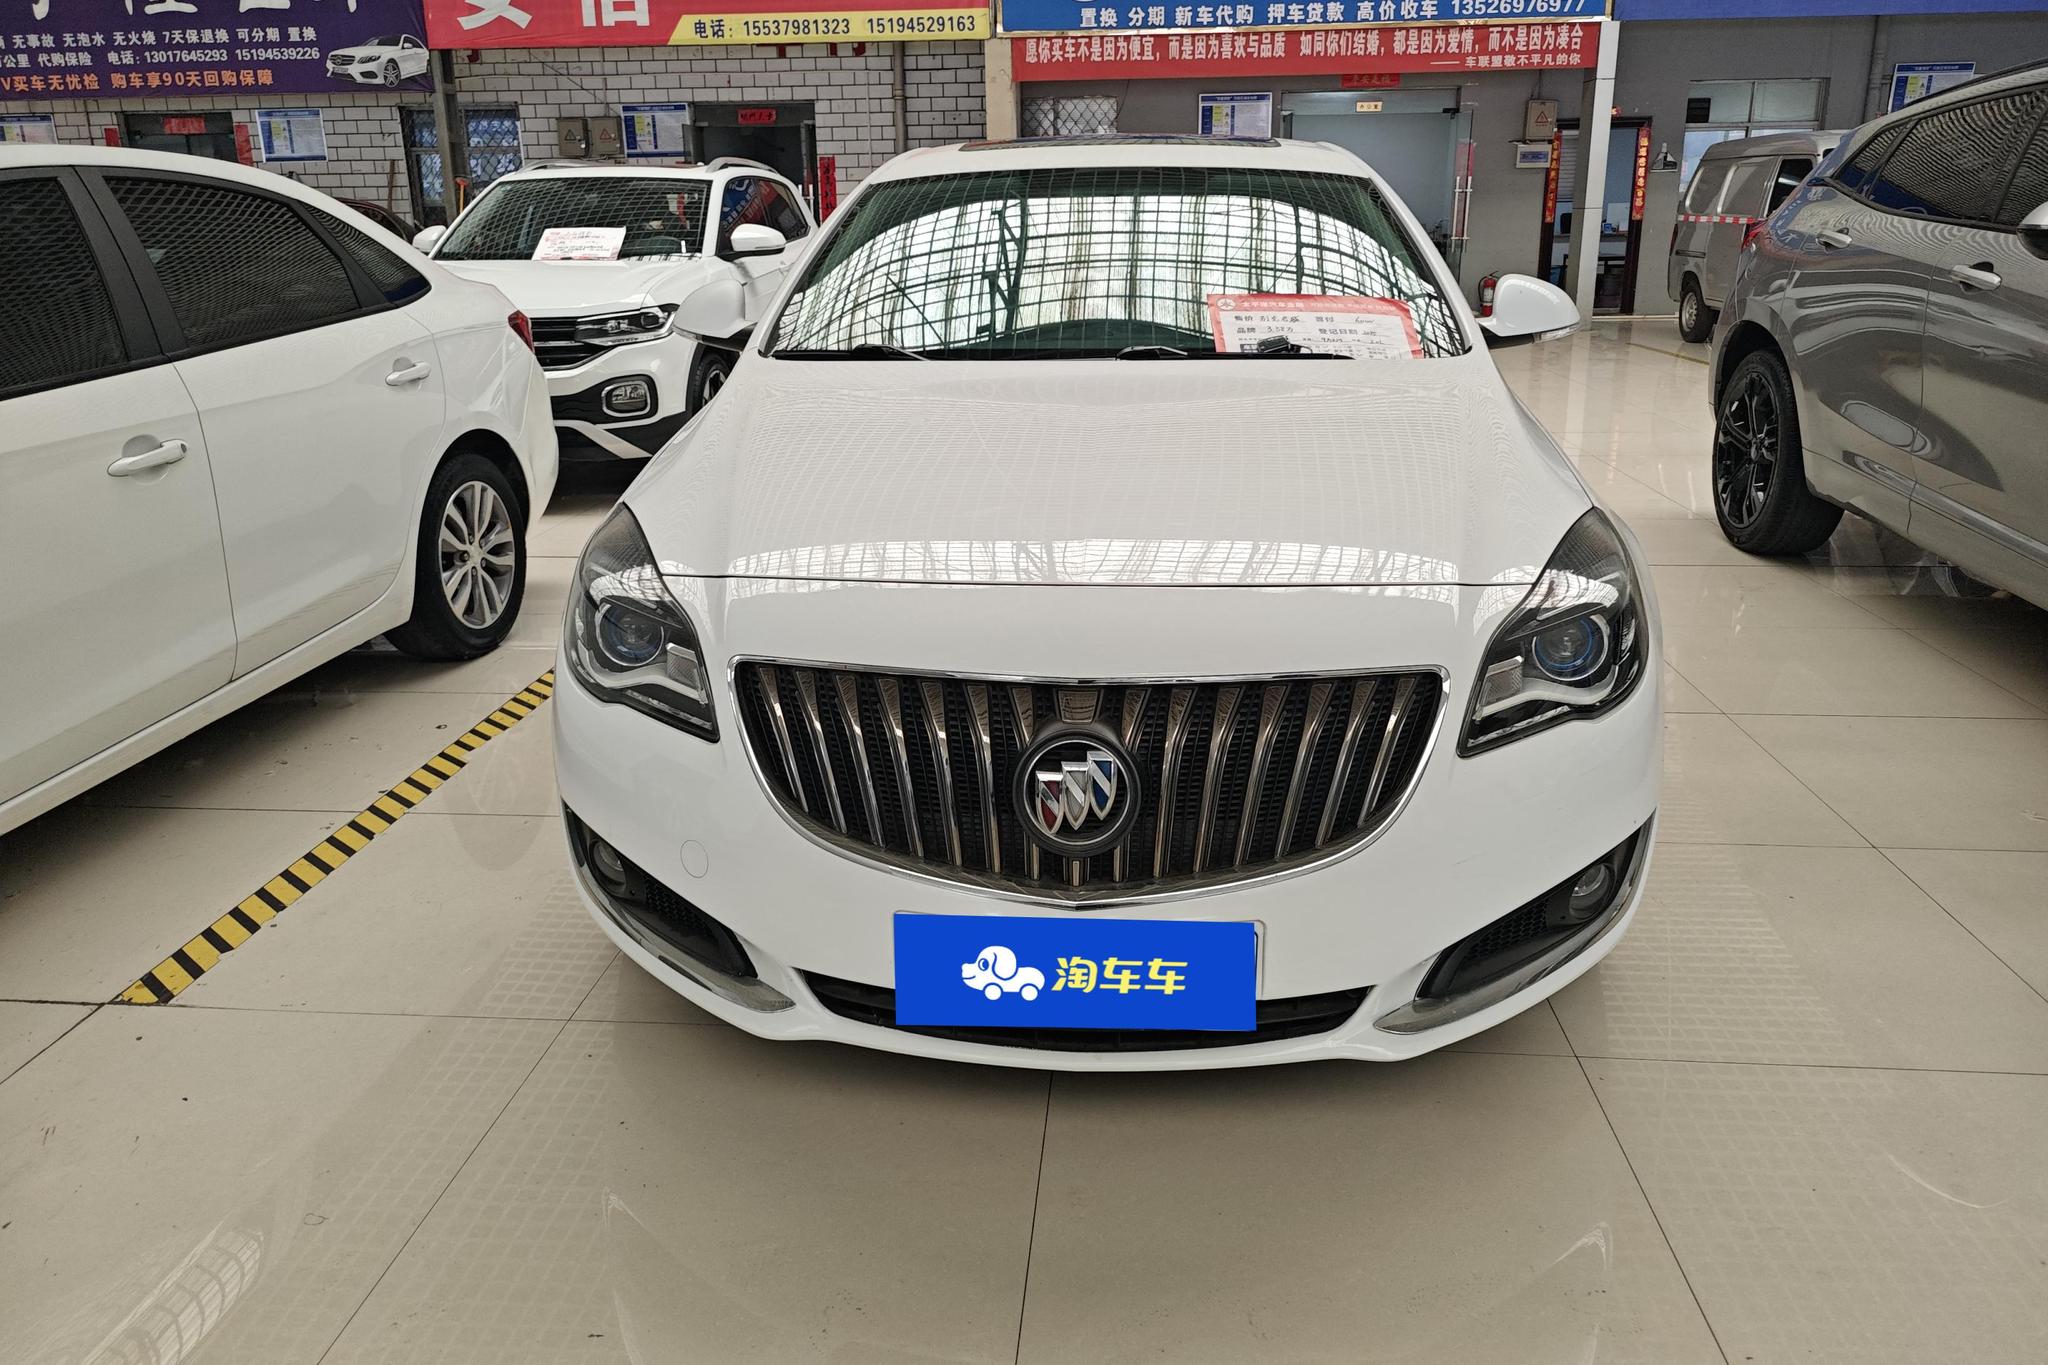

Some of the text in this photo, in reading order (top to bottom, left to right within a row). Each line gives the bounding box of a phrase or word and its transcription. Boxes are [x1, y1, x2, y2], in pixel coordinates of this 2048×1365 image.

[1080, 7, 1118, 28] 置换
[1128, 6, 1165, 27] 分期
[1175, 5, 1254, 26] 新车代购
[1267, 2, 1344, 25] 押车贷款
[1356, 0, 1438, 20] 高价收车
[743, 18, 850, 36] 15537981323
[867, 15, 976, 34] 15194529163
[12, 34, 55, 49] 无事故
[62, 31, 106, 48] 无泡水
[113, 30, 157, 46] 无火烧
[162, 28, 230, 44] 7天保退换
[236, 27, 280, 43] 可分期
[288, 26, 317, 42] 置换
[0, 53, 31, 68] 公里
[38, 52, 93, 67] 代购保险
[235, 47, 320, 61] 15194539226
[111, 69, 273, 89] 购车享90天回购保障
